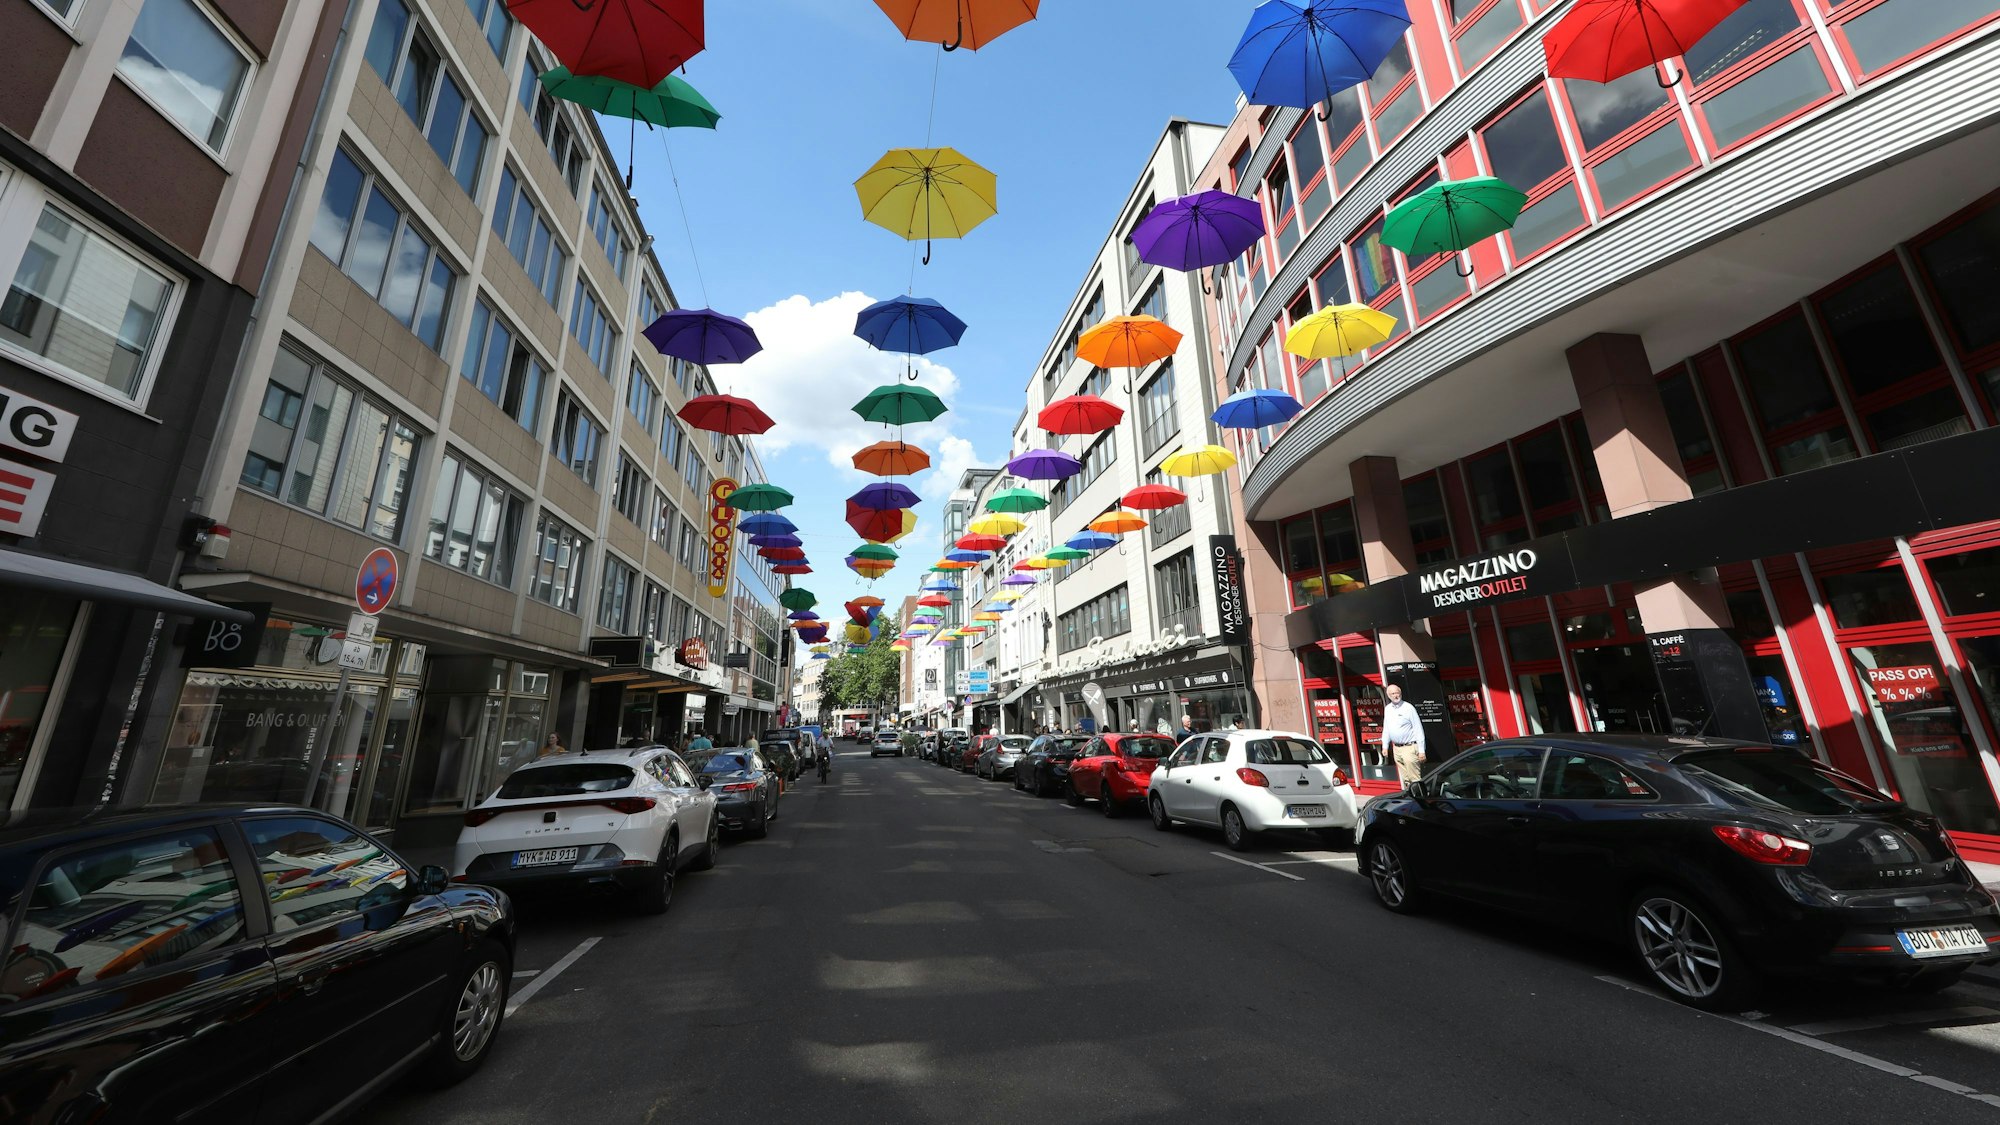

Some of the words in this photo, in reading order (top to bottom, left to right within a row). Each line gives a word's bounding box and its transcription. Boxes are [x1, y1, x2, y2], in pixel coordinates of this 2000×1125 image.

[714, 484, 733, 577] GLORIA
[1420, 549, 1536, 594] MAGAZZINO
[1215, 546, 1235, 634] MAGAZZINO
[1869, 671, 1905, 682] PASS
[1908, 668, 1934, 680] OP!
[246, 713, 284, 727] BANG
[287, 713, 295, 727] &
[297, 713, 347, 728] OLUFEN
[519, 851, 538, 863] MYK
[544, 850, 557, 861] AB
[559, 849, 577, 860] 911
[1879, 868, 1922, 877] IBIZA
